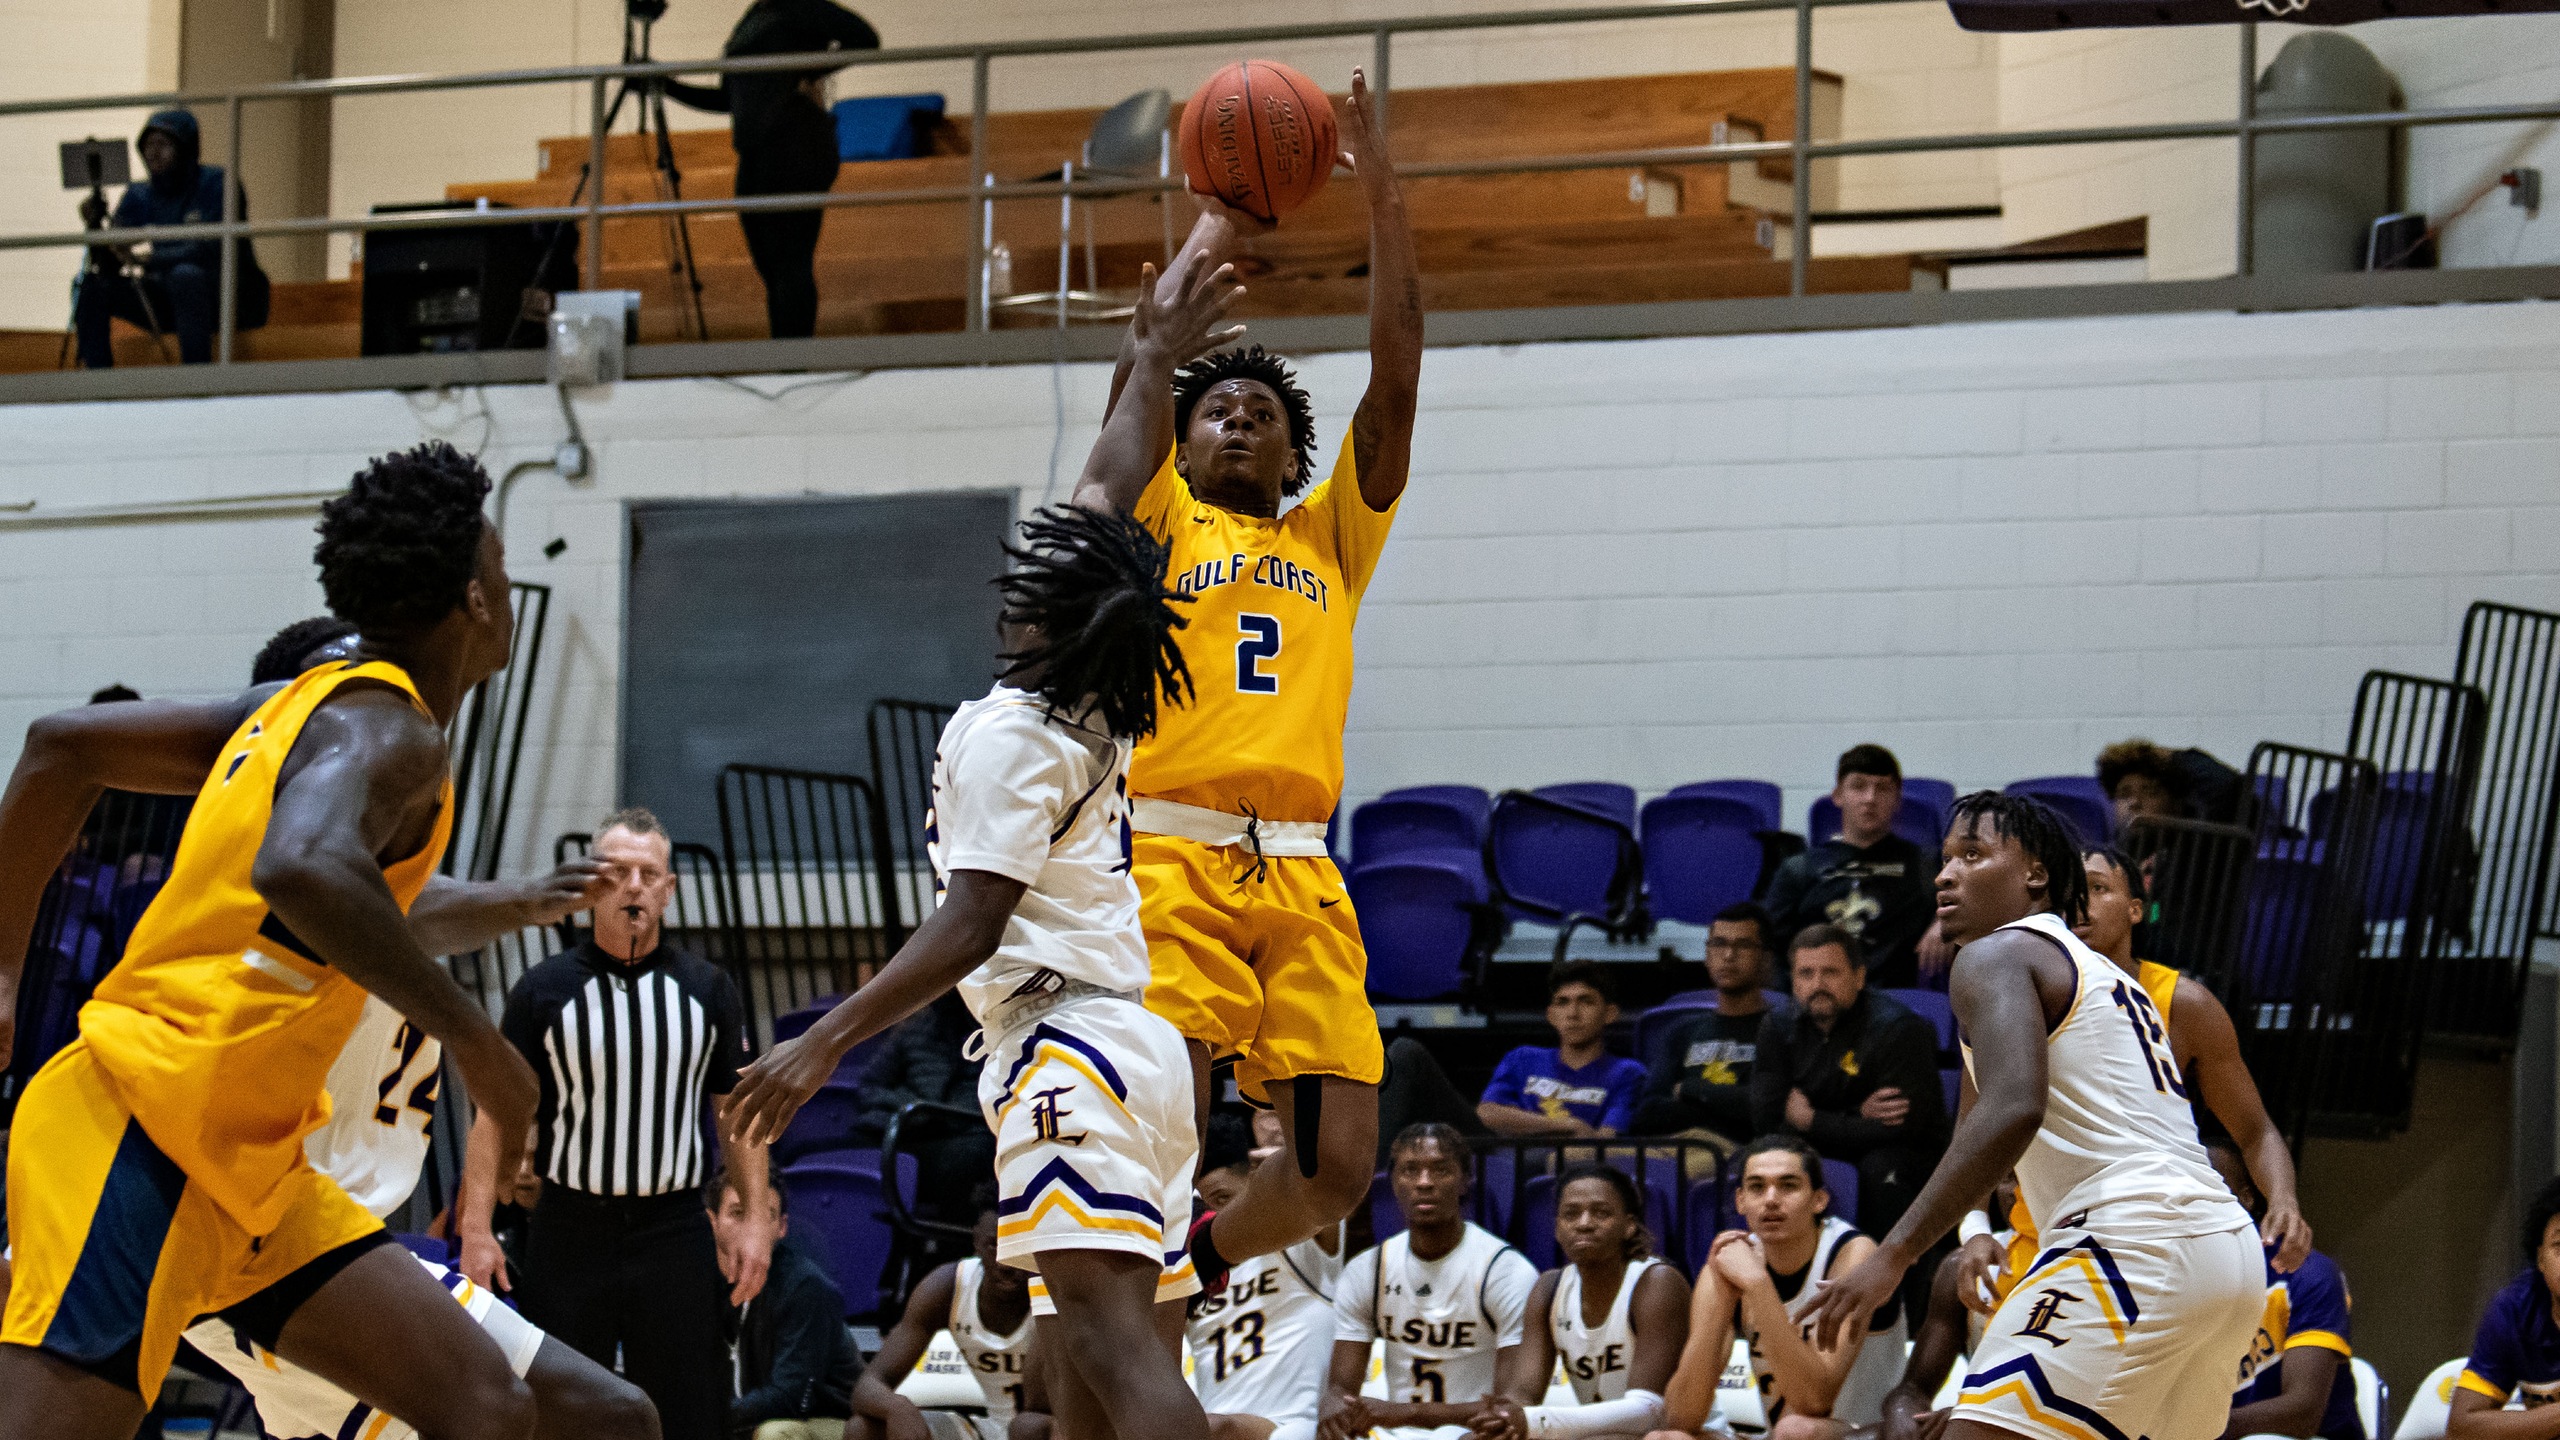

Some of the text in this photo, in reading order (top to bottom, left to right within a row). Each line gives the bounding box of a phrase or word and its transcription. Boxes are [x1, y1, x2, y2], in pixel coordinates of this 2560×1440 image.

[1216, 95, 1257, 200] SPALDING
[1262, 95, 1293, 186] LEGACY
[1176, 553, 1328, 614] GULF COAST
[1235, 611, 1282, 696] 2
[1207, 1310, 1267, 1383] 13
[1383, 1315, 1477, 1349] LSUE
[1409, 1356, 1446, 1404] 5
